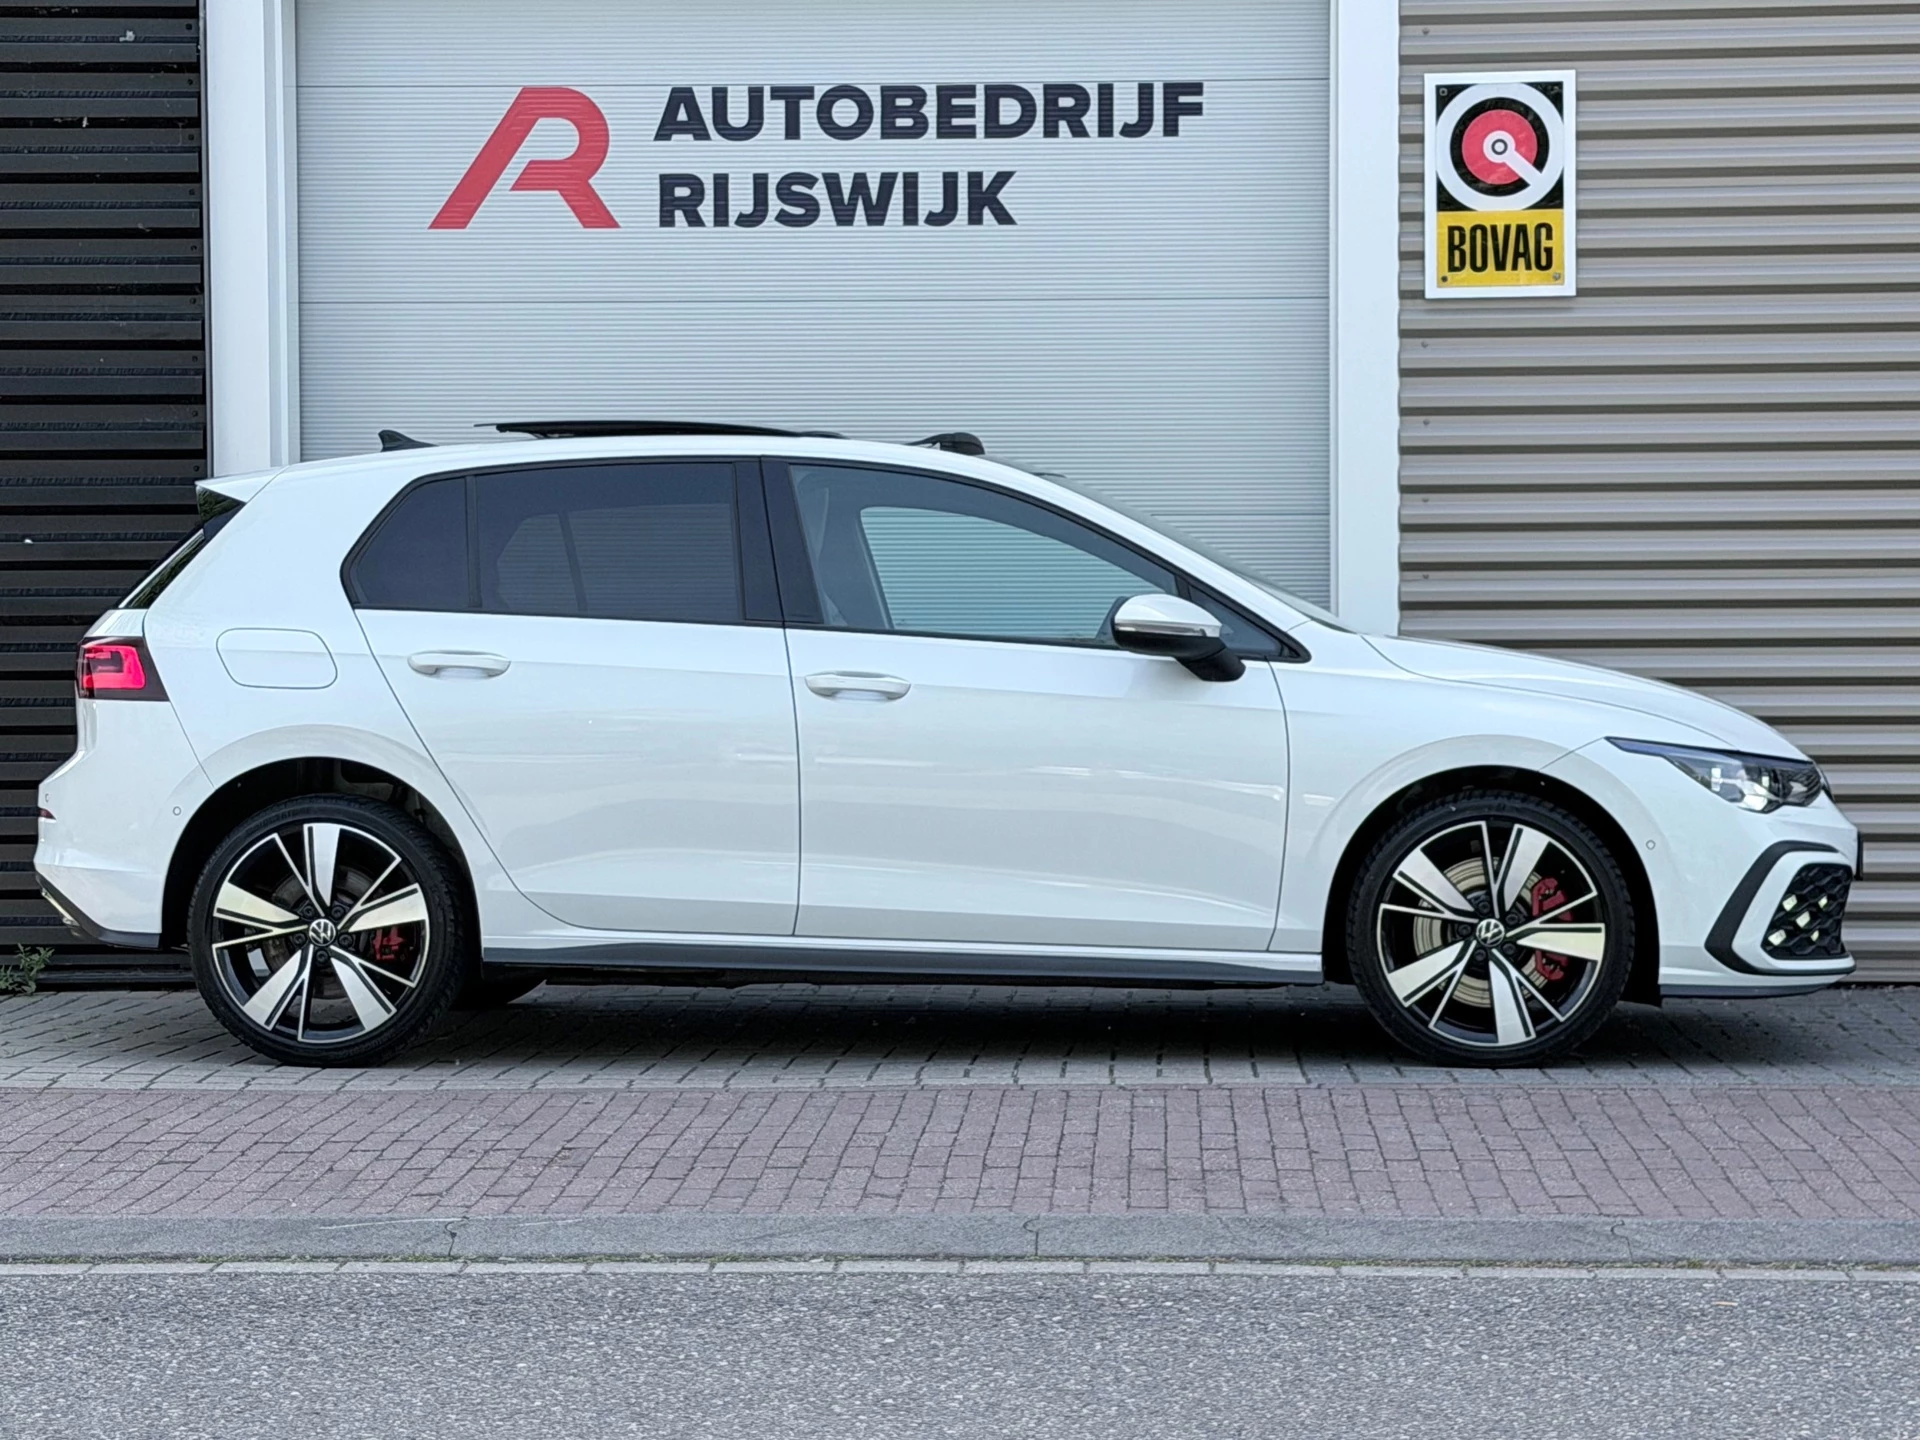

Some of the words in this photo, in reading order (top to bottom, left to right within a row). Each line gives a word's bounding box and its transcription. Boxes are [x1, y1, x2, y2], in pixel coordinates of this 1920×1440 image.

[654, 82, 1204, 141] AUTOBEDRIJF
[659, 171, 1018, 228] RIJSWIJK
[1447, 222, 1554, 273] BOVAG
